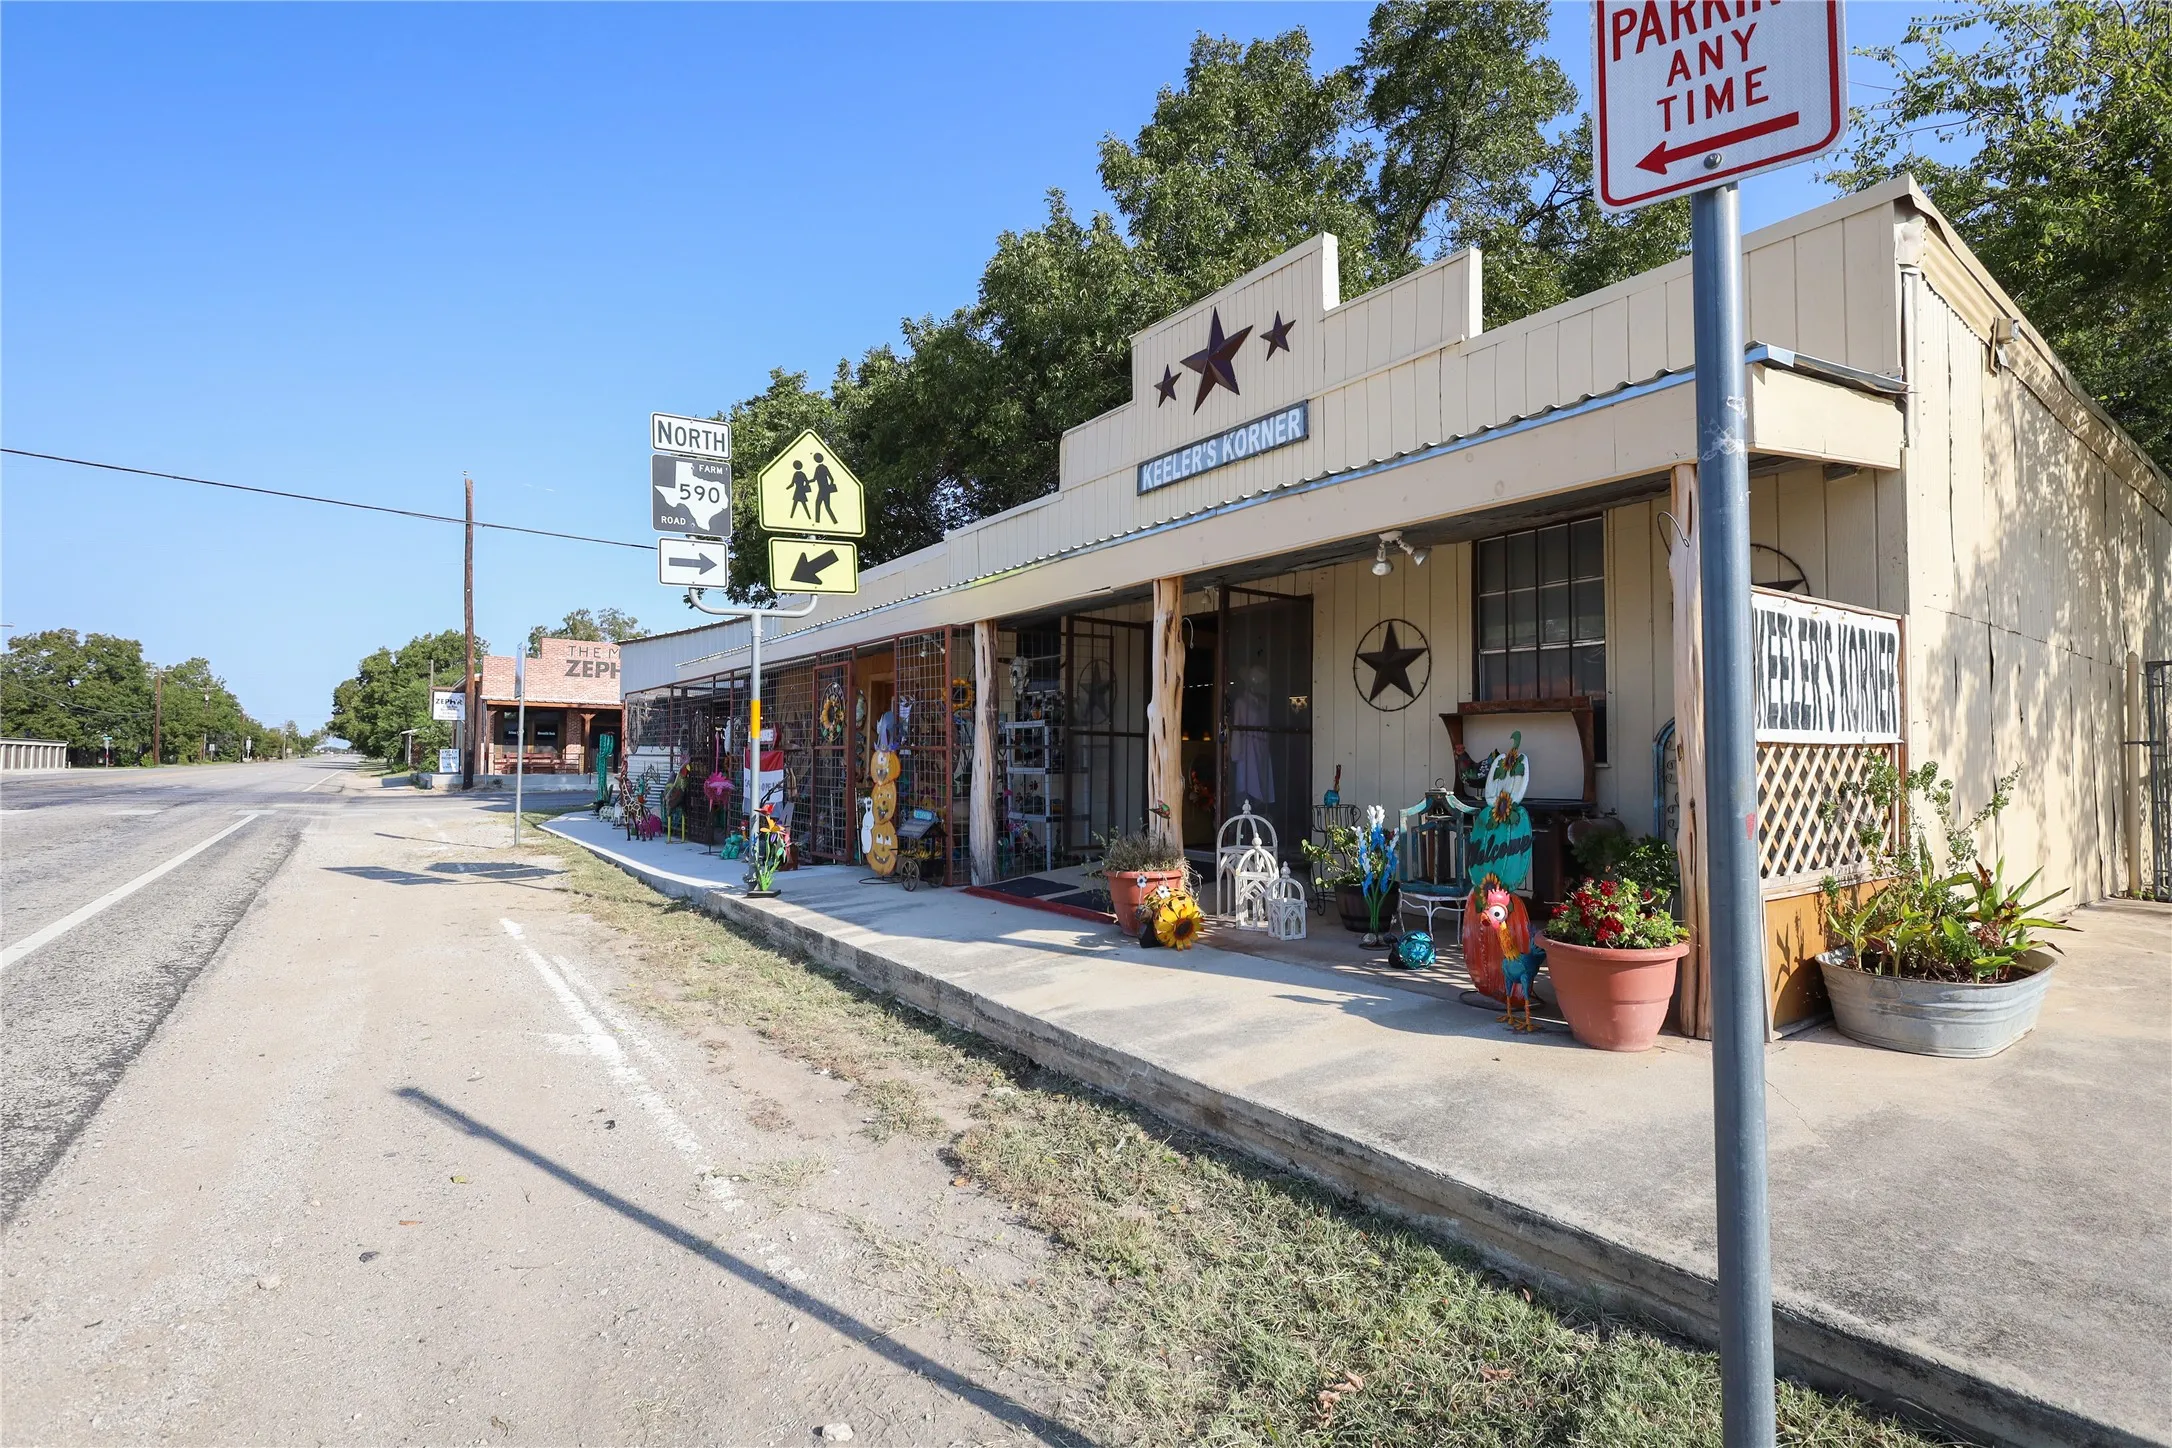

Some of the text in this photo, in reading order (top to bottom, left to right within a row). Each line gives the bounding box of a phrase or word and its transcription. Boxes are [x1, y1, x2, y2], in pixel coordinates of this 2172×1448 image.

[1667, 22, 1757, 87] ANY
[1657, 66, 1769, 132] TIME
[658, 420, 725, 452] NORTH
[1143, 408, 1301, 491] KEELER'S KORNER
[699, 464, 723, 475] FARM
[679, 483, 720, 504] 590
[661, 515, 686, 526] ROAD
[568, 645, 601, 658] THE
[1754, 607, 1896, 733] KEELER'S KORNER
[1467, 834, 1535, 869] Welcome
